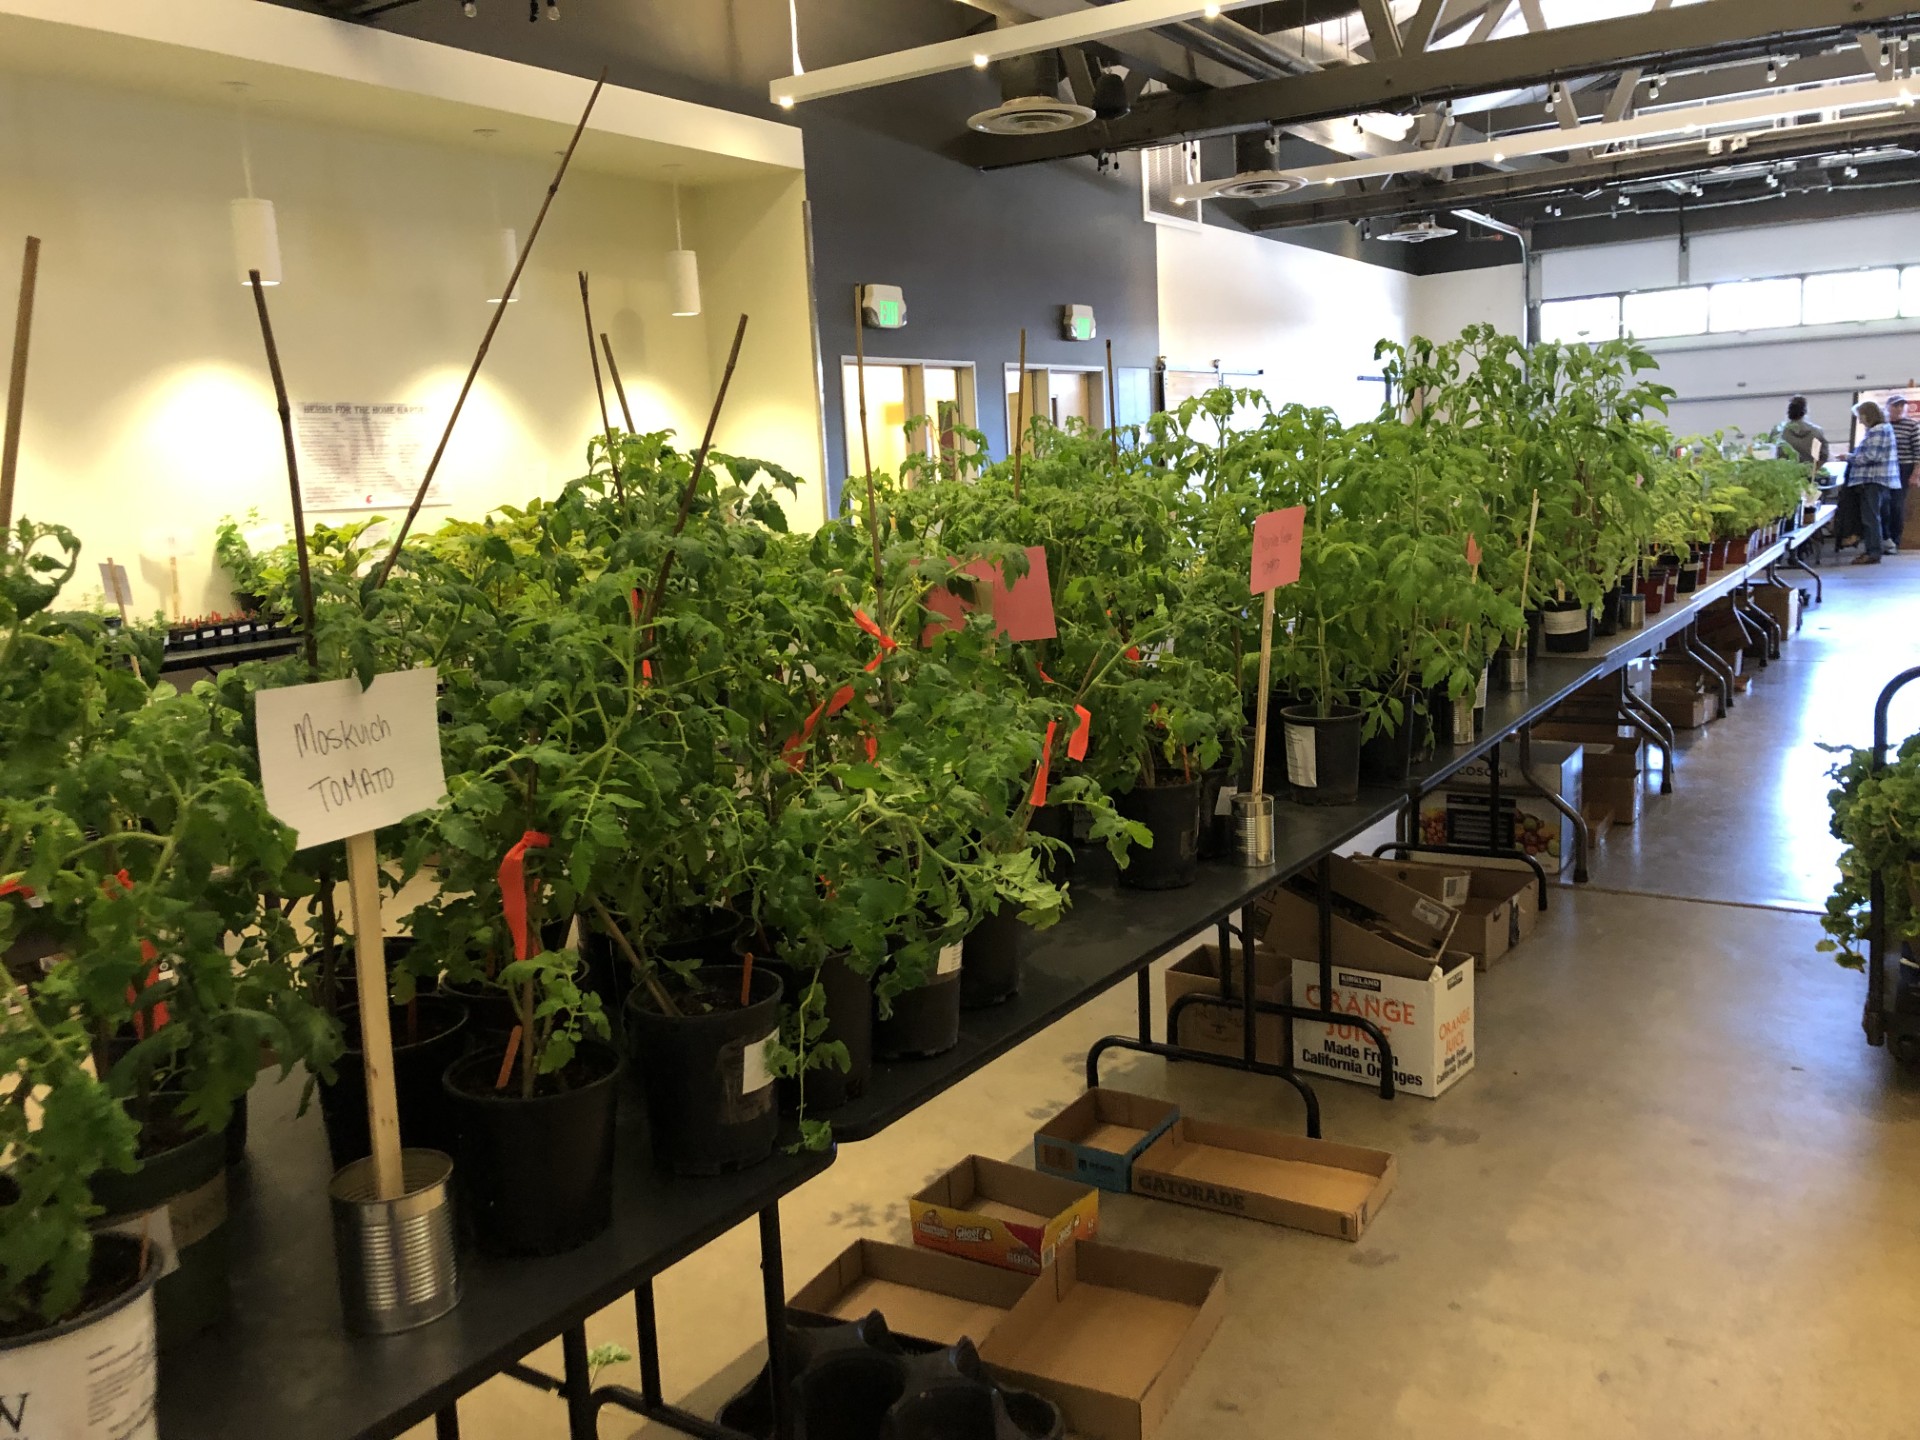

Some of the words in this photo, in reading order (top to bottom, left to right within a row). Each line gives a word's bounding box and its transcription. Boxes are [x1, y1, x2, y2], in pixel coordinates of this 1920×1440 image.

[335, 405, 352, 414] FOR
[354, 405, 370, 415] THE
[308, 767, 395, 813] TOMATO
[1341, 974, 1379, 987] KIRKLAND
[1324, 1039, 1360, 1059] Made
[1302, 1048, 1362, 1074] California
[1367, 1064, 1423, 1086] Ornges
[1138, 1174, 1245, 1211] GATORADE
